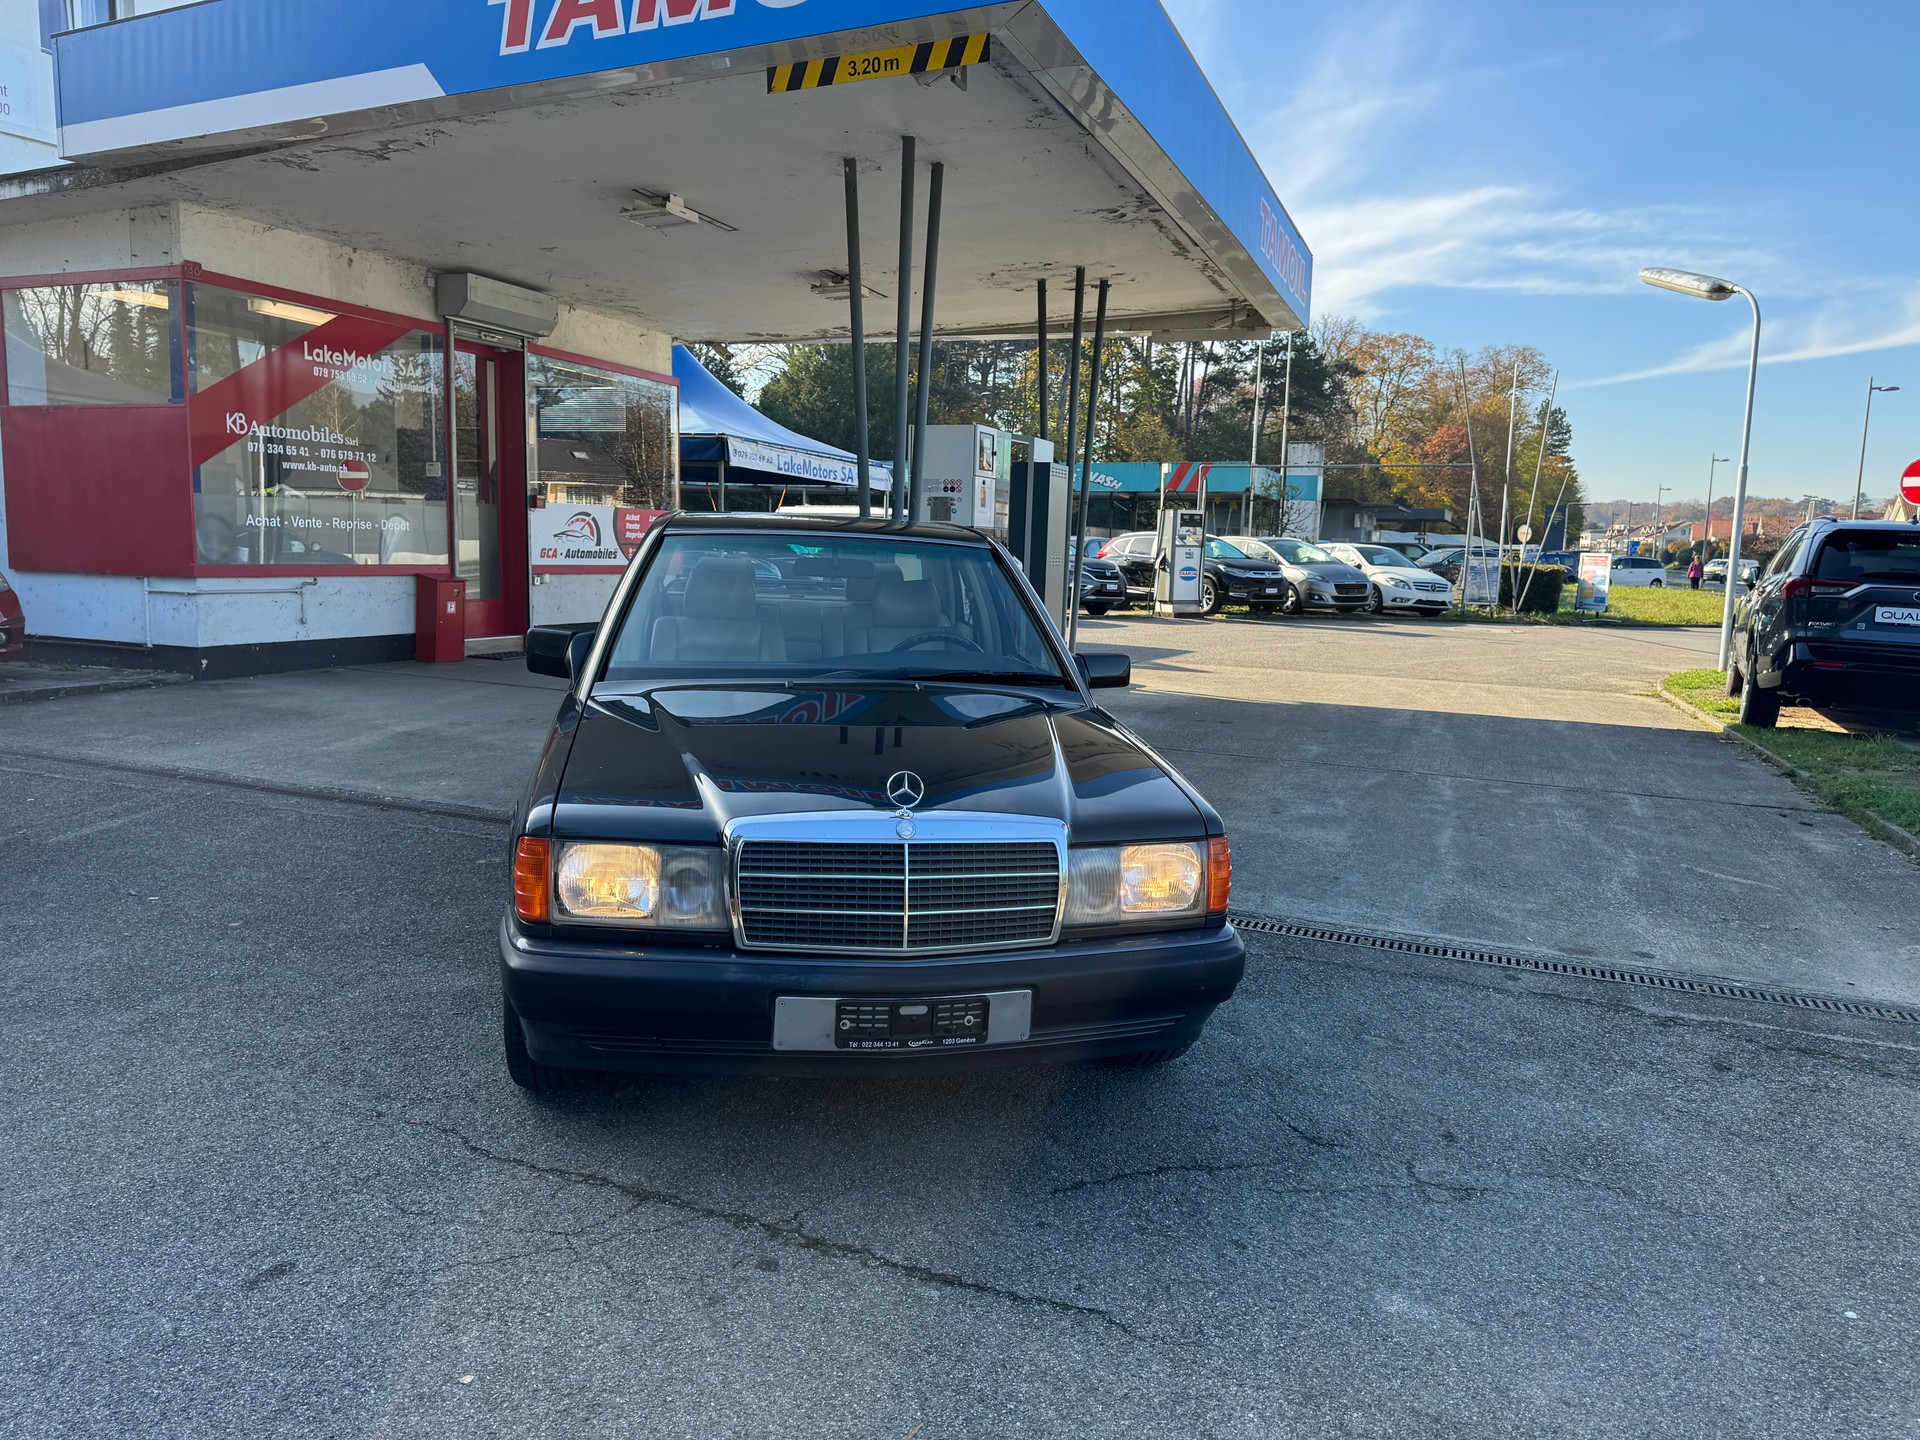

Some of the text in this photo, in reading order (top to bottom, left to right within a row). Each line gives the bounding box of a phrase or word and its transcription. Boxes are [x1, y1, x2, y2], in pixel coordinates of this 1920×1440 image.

[486, 0, 818, 56] TA
[1260, 195, 1307, 308] TAMOIL
[303, 340, 416, 378] LakeMotors SA
[313, 366, 329, 378] 079
[330, 368, 344, 380] 753
[346, 371, 356, 382] 69
[357, 373, 367, 384] 62
[226, 411, 248, 434] KB
[248, 419, 344, 445] Automobiles
[247, 441, 265, 453] 079
[266, 443, 283, 455] 334
[286, 445, 297, 456] 65
[299, 447, 310, 457] 41
[320, 449, 336, 459] 076
[338, 451, 353, 460] 679
[354, 452, 364, 461] 77
[366, 453, 377, 463] 12
[282, 460, 348, 473] www.kb-auto.ch
[737, 450, 748, 459] 079
[776, 453, 838, 481] LakeMotors
[840, 465, 854, 483] SA
[245, 513, 281, 528] Achat
[290, 515, 323, 529] Vente
[332, 517, 372, 532] Reprise
[625, 513, 641, 521] Achat
[625, 522, 640, 530] Vente
[539, 547, 618, 560] GCA Automobiles
[942, 1037, 955, 1045] 1203
